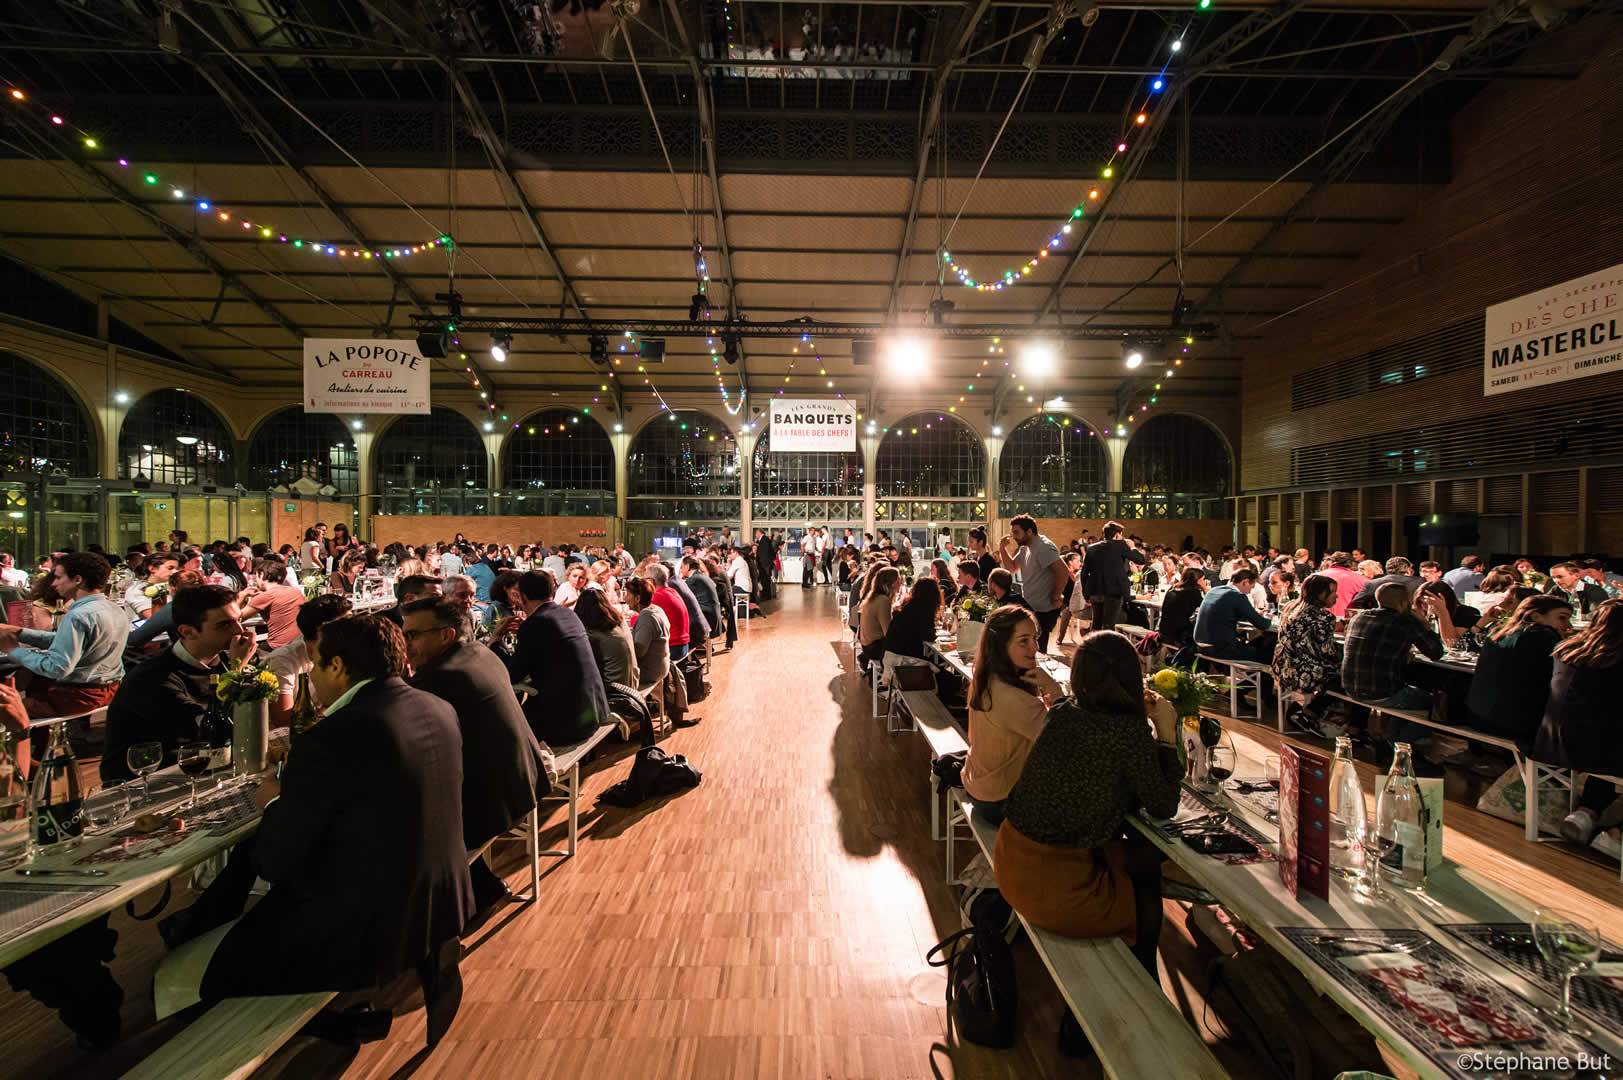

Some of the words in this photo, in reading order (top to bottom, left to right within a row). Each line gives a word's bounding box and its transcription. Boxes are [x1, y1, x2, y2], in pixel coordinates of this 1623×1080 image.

[1511, 312, 1553, 334] DES
[1491, 320, 1622, 369] MASTERCL
[315, 351, 340, 368] LA
[346, 345, 422, 371] POPOTE
[342, 370, 393, 379] CARREAU
[1491, 376, 1519, 387] SAMEDI
[1574, 353, 1622, 370] DIMANCHE
[327, 382, 363, 394] Ateliers
[364, 384, 374, 394] de
[376, 386, 408, 394] cuisine
[774, 414, 853, 425] BANQUETS
[791, 429, 810, 437] TABLE
[812, 429, 825, 437] DES
